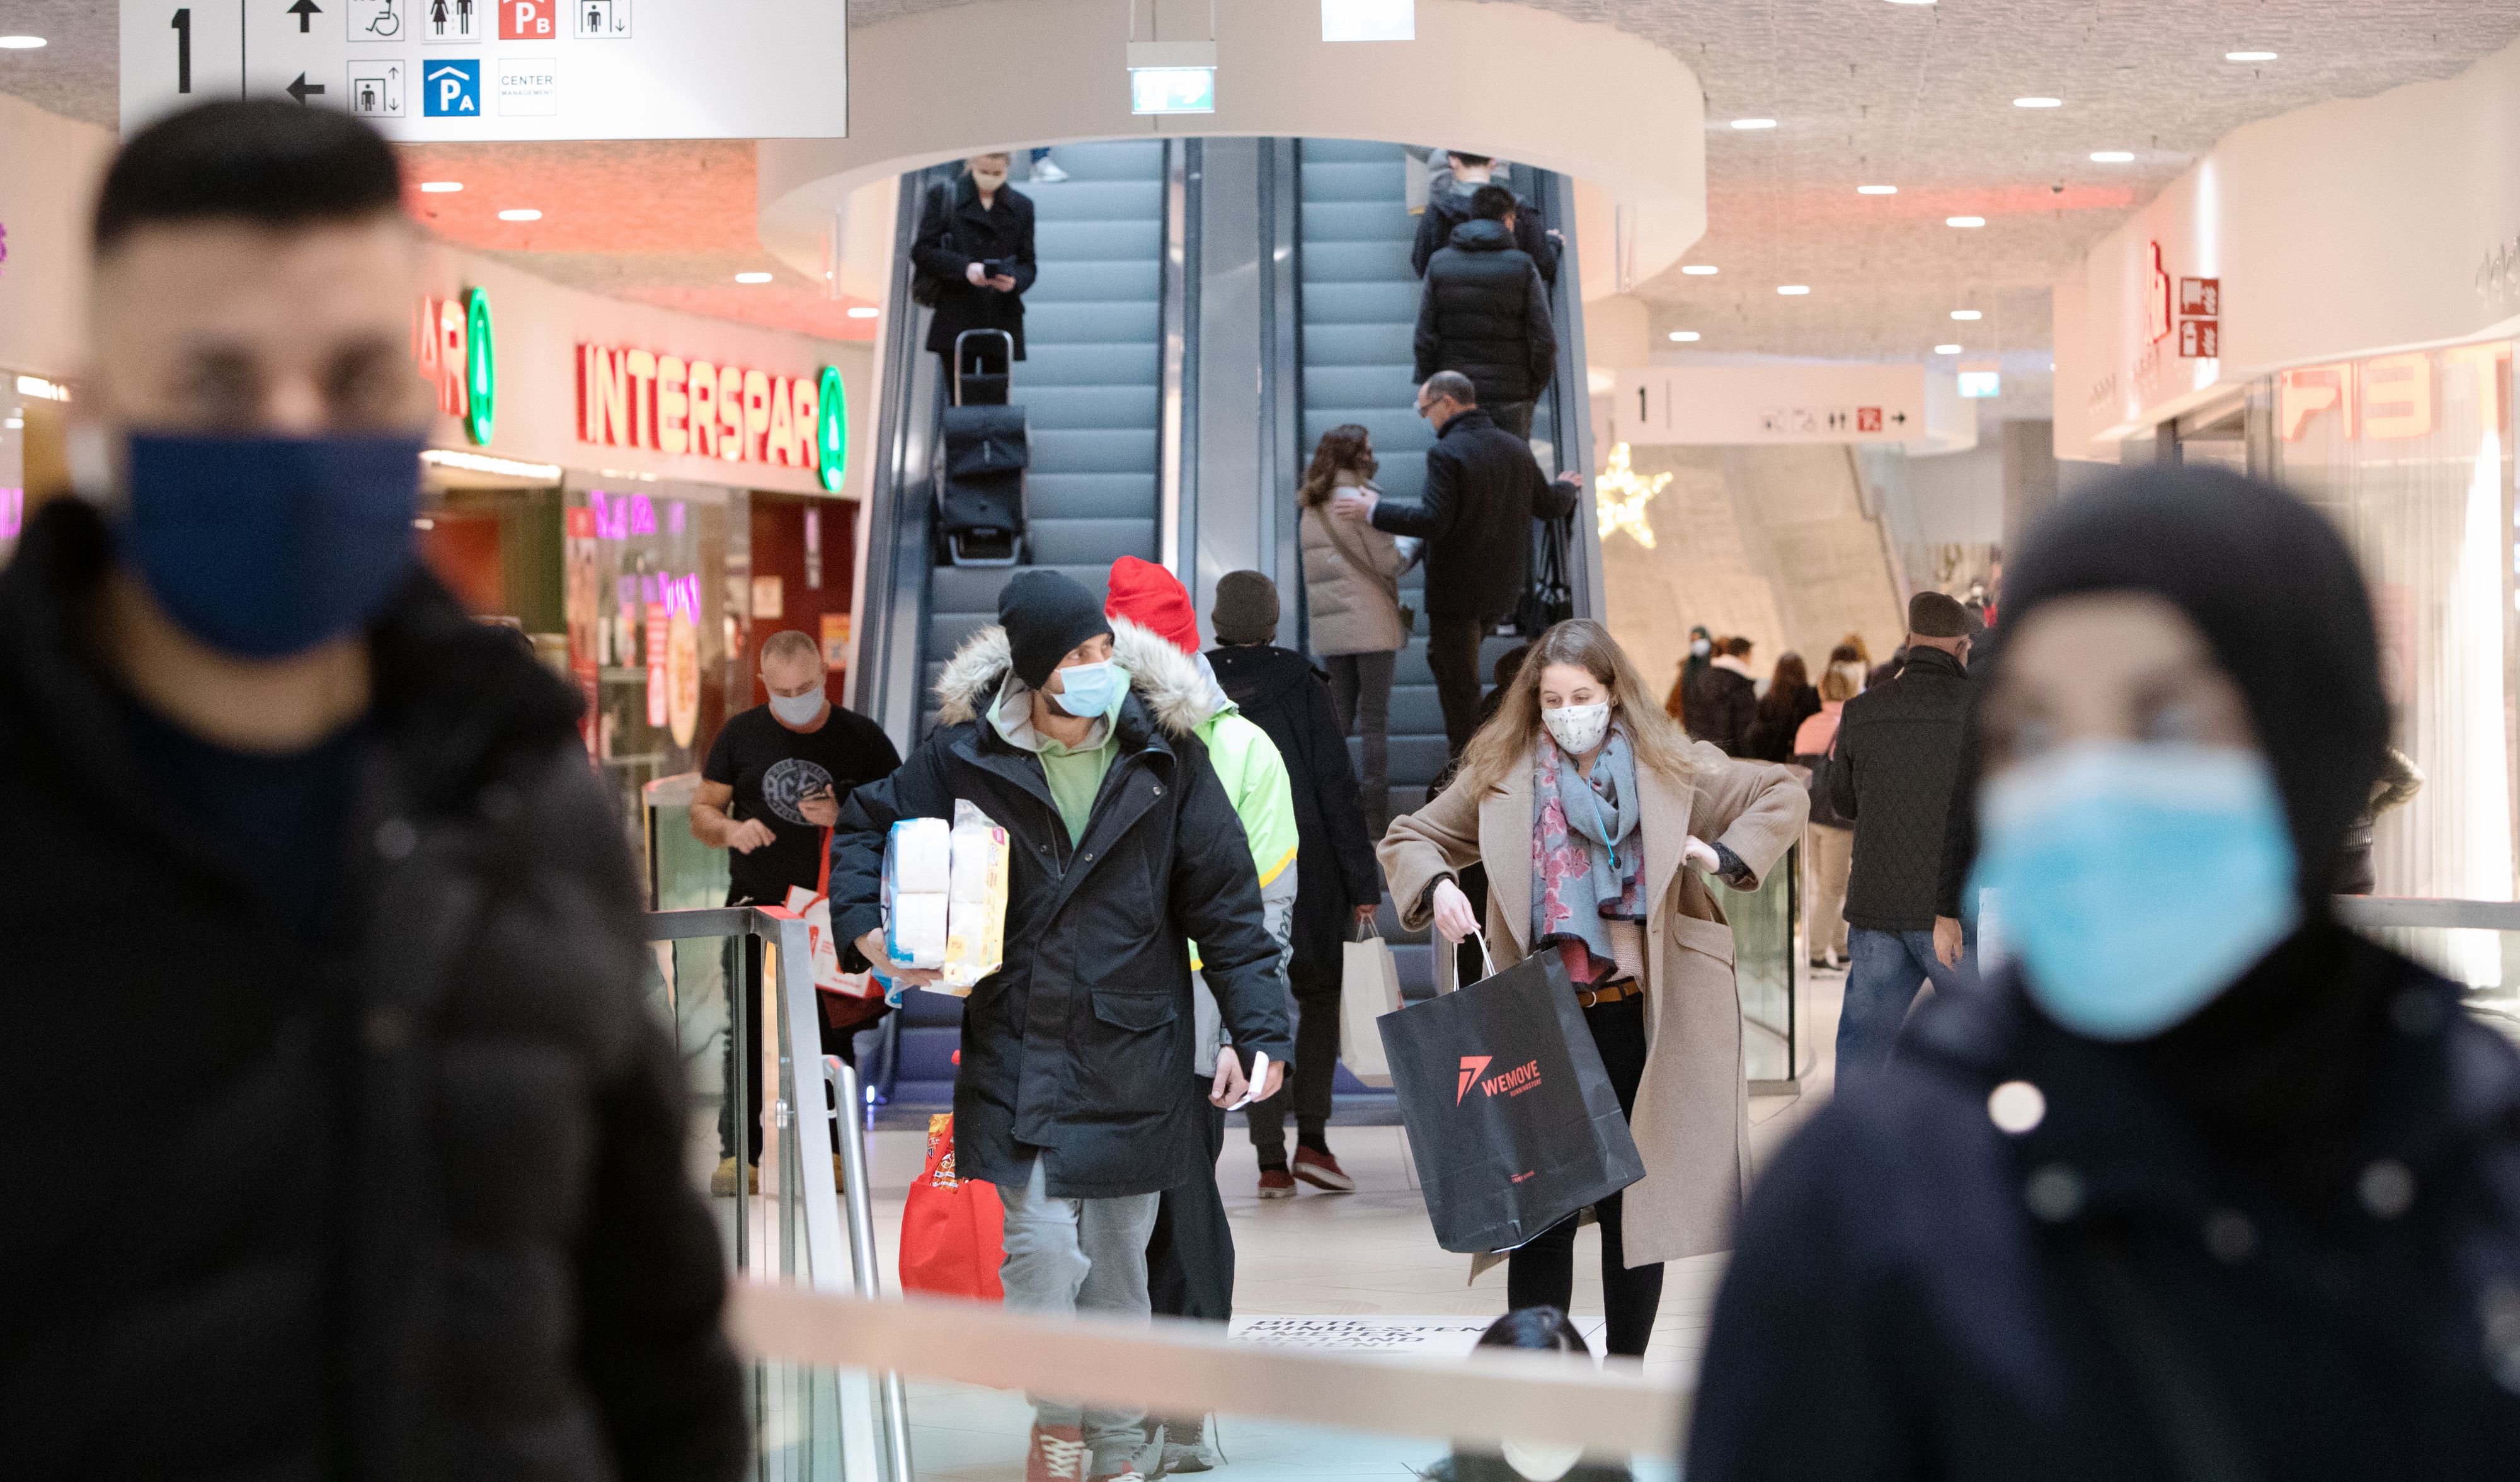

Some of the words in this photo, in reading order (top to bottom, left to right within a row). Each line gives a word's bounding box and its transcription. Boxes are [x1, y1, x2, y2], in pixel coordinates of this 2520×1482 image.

[171, 9, 191, 93] 1
[501, 76, 553, 86] CENTER
[576, 342, 820, 472] INTERSPAR
[1639, 386, 1646, 422] 1
[1481, 1059, 1540, 1097] WEMOVE
